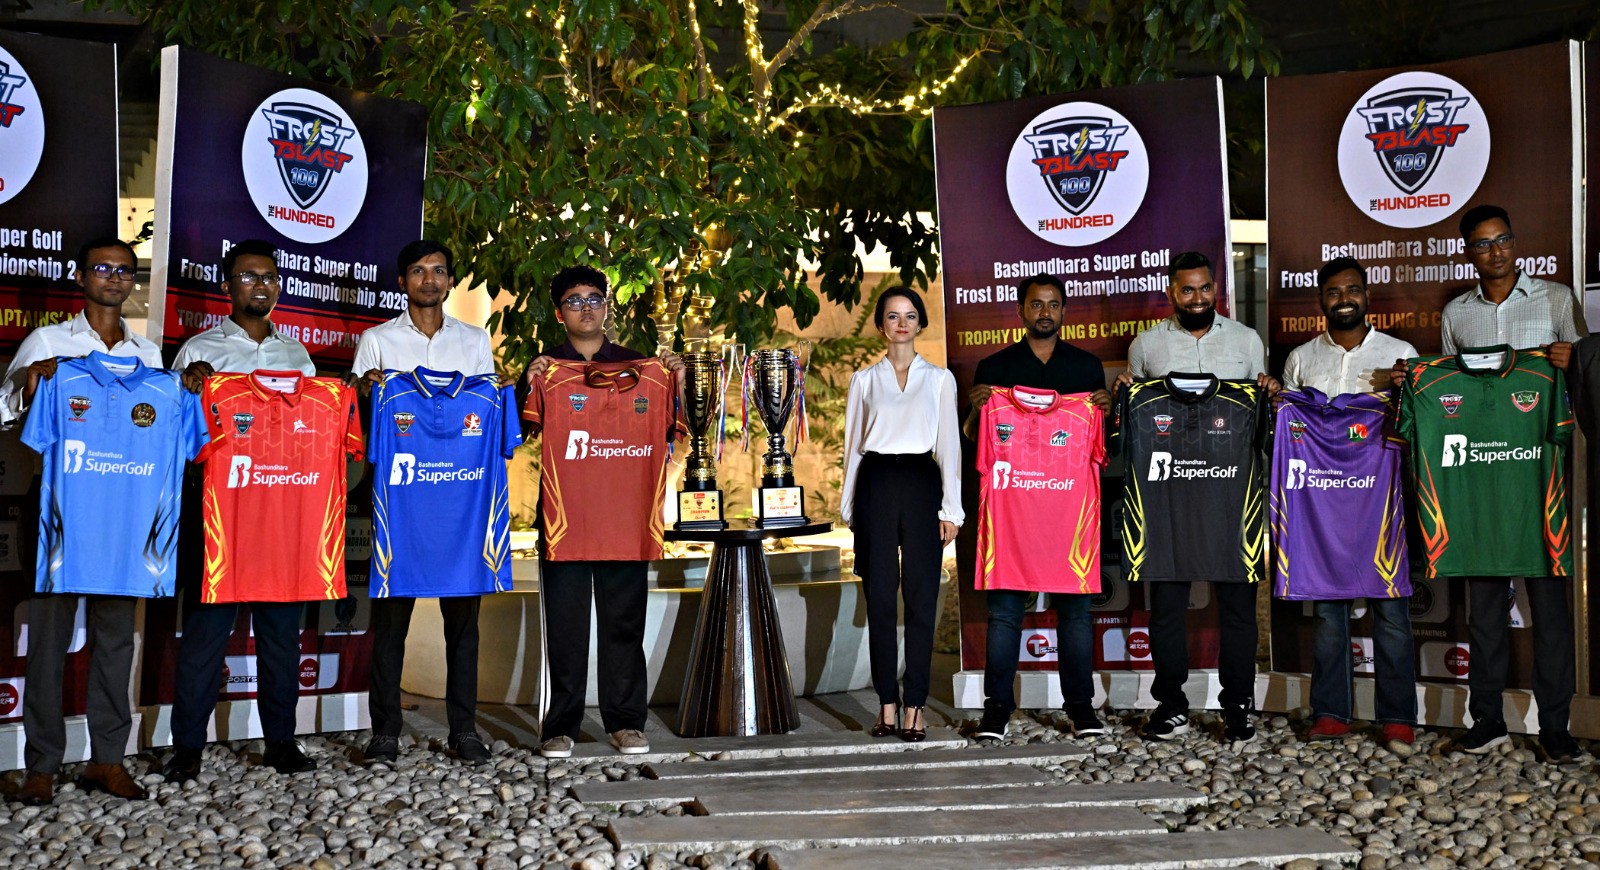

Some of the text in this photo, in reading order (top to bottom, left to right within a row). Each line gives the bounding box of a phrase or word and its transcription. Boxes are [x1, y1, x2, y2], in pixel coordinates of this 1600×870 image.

[1357, 96, 1470, 132] FROST
[262, 109, 355, 153] FROST
[1366, 124, 1470, 152] BLAST
[1024, 125, 1129, 157] FROST
[268, 137, 353, 173] BLAST
[1032, 150, 1129, 176] BLAST
[1393, 152, 1427, 171] 100
[290, 167, 318, 188] 100
[1060, 177, 1091, 194] 100
[1377, 193, 1450, 211] HUNDRED
[274, 206, 335, 229] HUNDRED
[1046, 214, 1113, 231] HUNDRED
[0, 228, 63, 251] per Golf
[1427, 237, 1467, 257] Supe
[181, 258, 218, 283] Frost
[313, 255, 351, 278] Super
[353, 261, 378, 283] Golf
[994, 248, 1170, 279] Bashundhara Super Golf
[1281, 256, 1557, 289] Frost 100 Champion 2026
[286, 276, 376, 309] Championship
[378, 290, 409, 311] 2026
[955, 272, 1170, 305] Frost Bla Championship
[177, 309, 229, 330] TROPH
[1281, 315, 1327, 333] TROPH
[957, 328, 1010, 346] TROPHY
[1088, 323, 1098, 340] &
[590, 444, 653, 459] SuperGolf
[1470, 441, 1508, 449] Bashundhara
[1469, 446, 1542, 464] SuperGolf
[84, 458, 155, 476] SuperGolf
[254, 463, 289, 471] Bashundhara
[416, 467, 485, 485] SuperGolf
[1172, 465, 1238, 480] SuperGolf
[252, 471, 320, 488] SuperGolf
[1011, 476, 1075, 492] SuperGolf
[1306, 475, 1376, 491] SuperGolf
[1421, 629, 1447, 638] PARTNER
